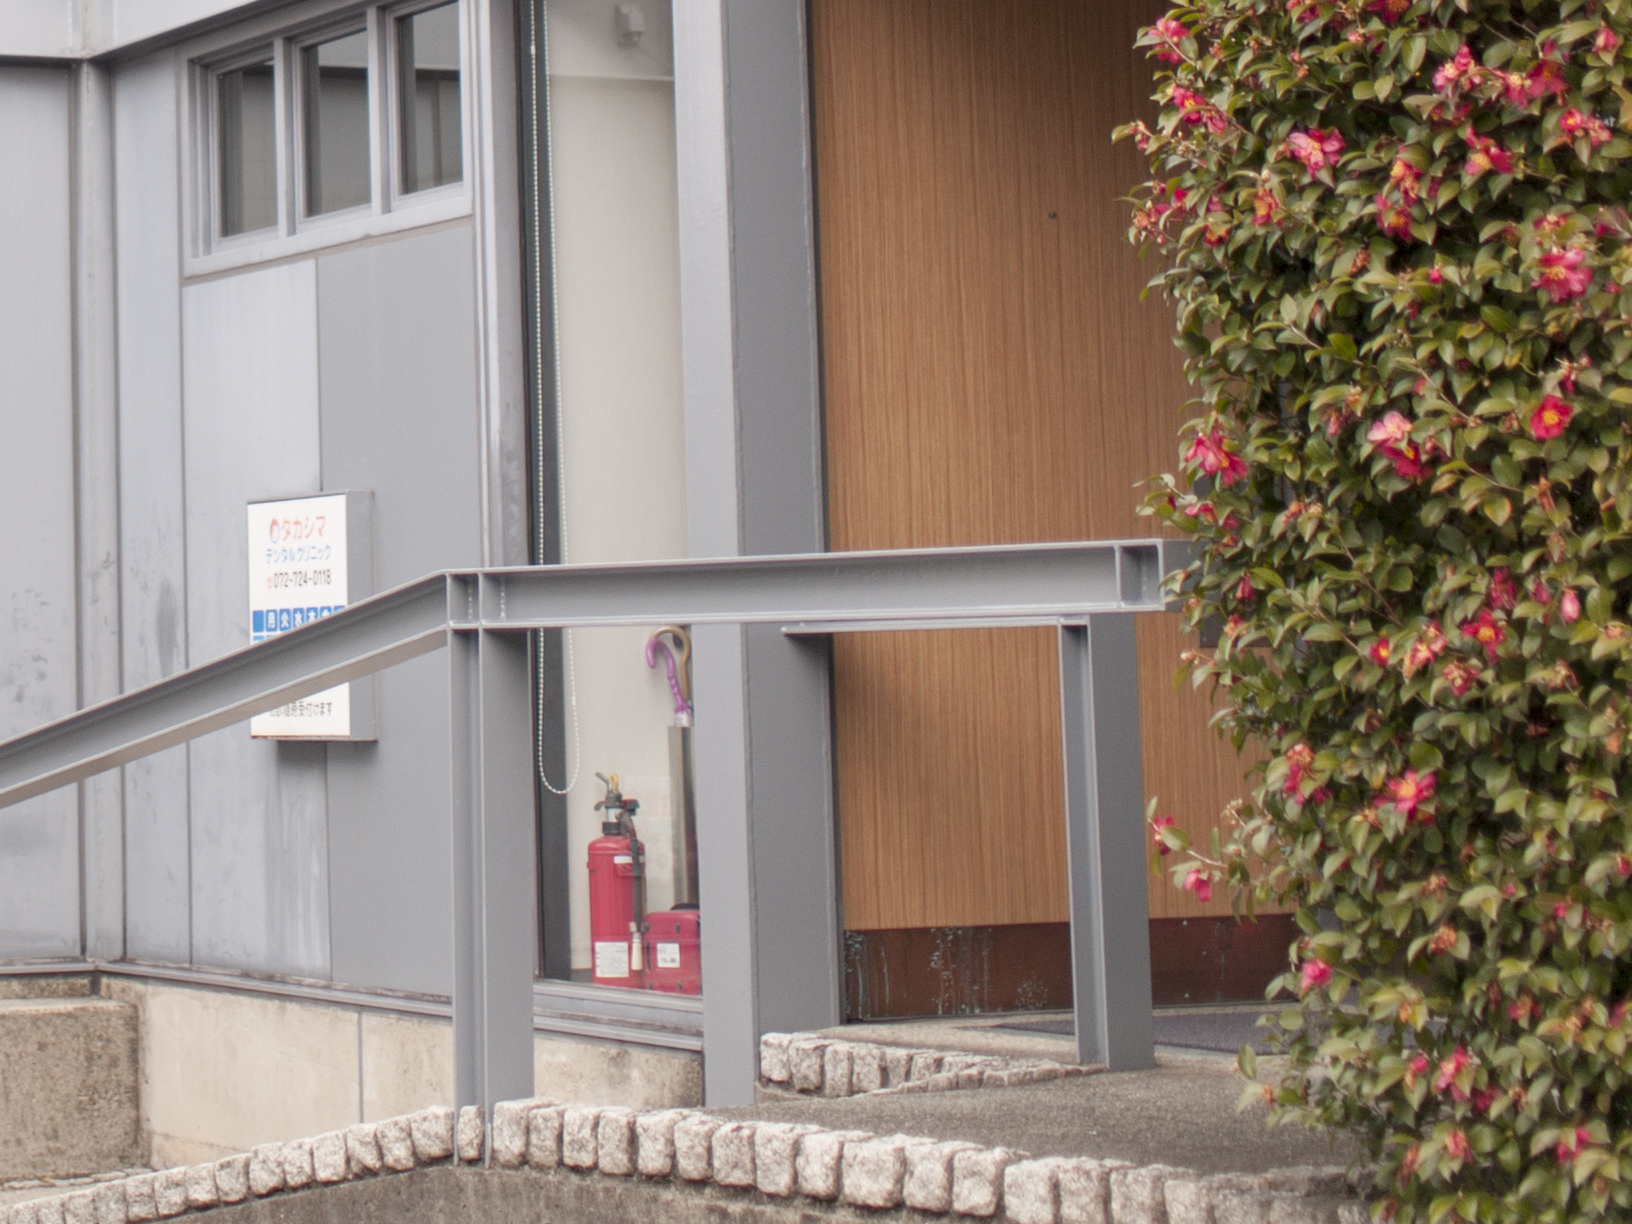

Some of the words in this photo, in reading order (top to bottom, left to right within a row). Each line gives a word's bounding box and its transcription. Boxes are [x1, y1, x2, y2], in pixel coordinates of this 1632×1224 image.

[282, 516, 326, 541] タカシマ
[266, 544, 331, 564] デンタルクリニック
[273, 568, 332, 589] 072-724-0118
